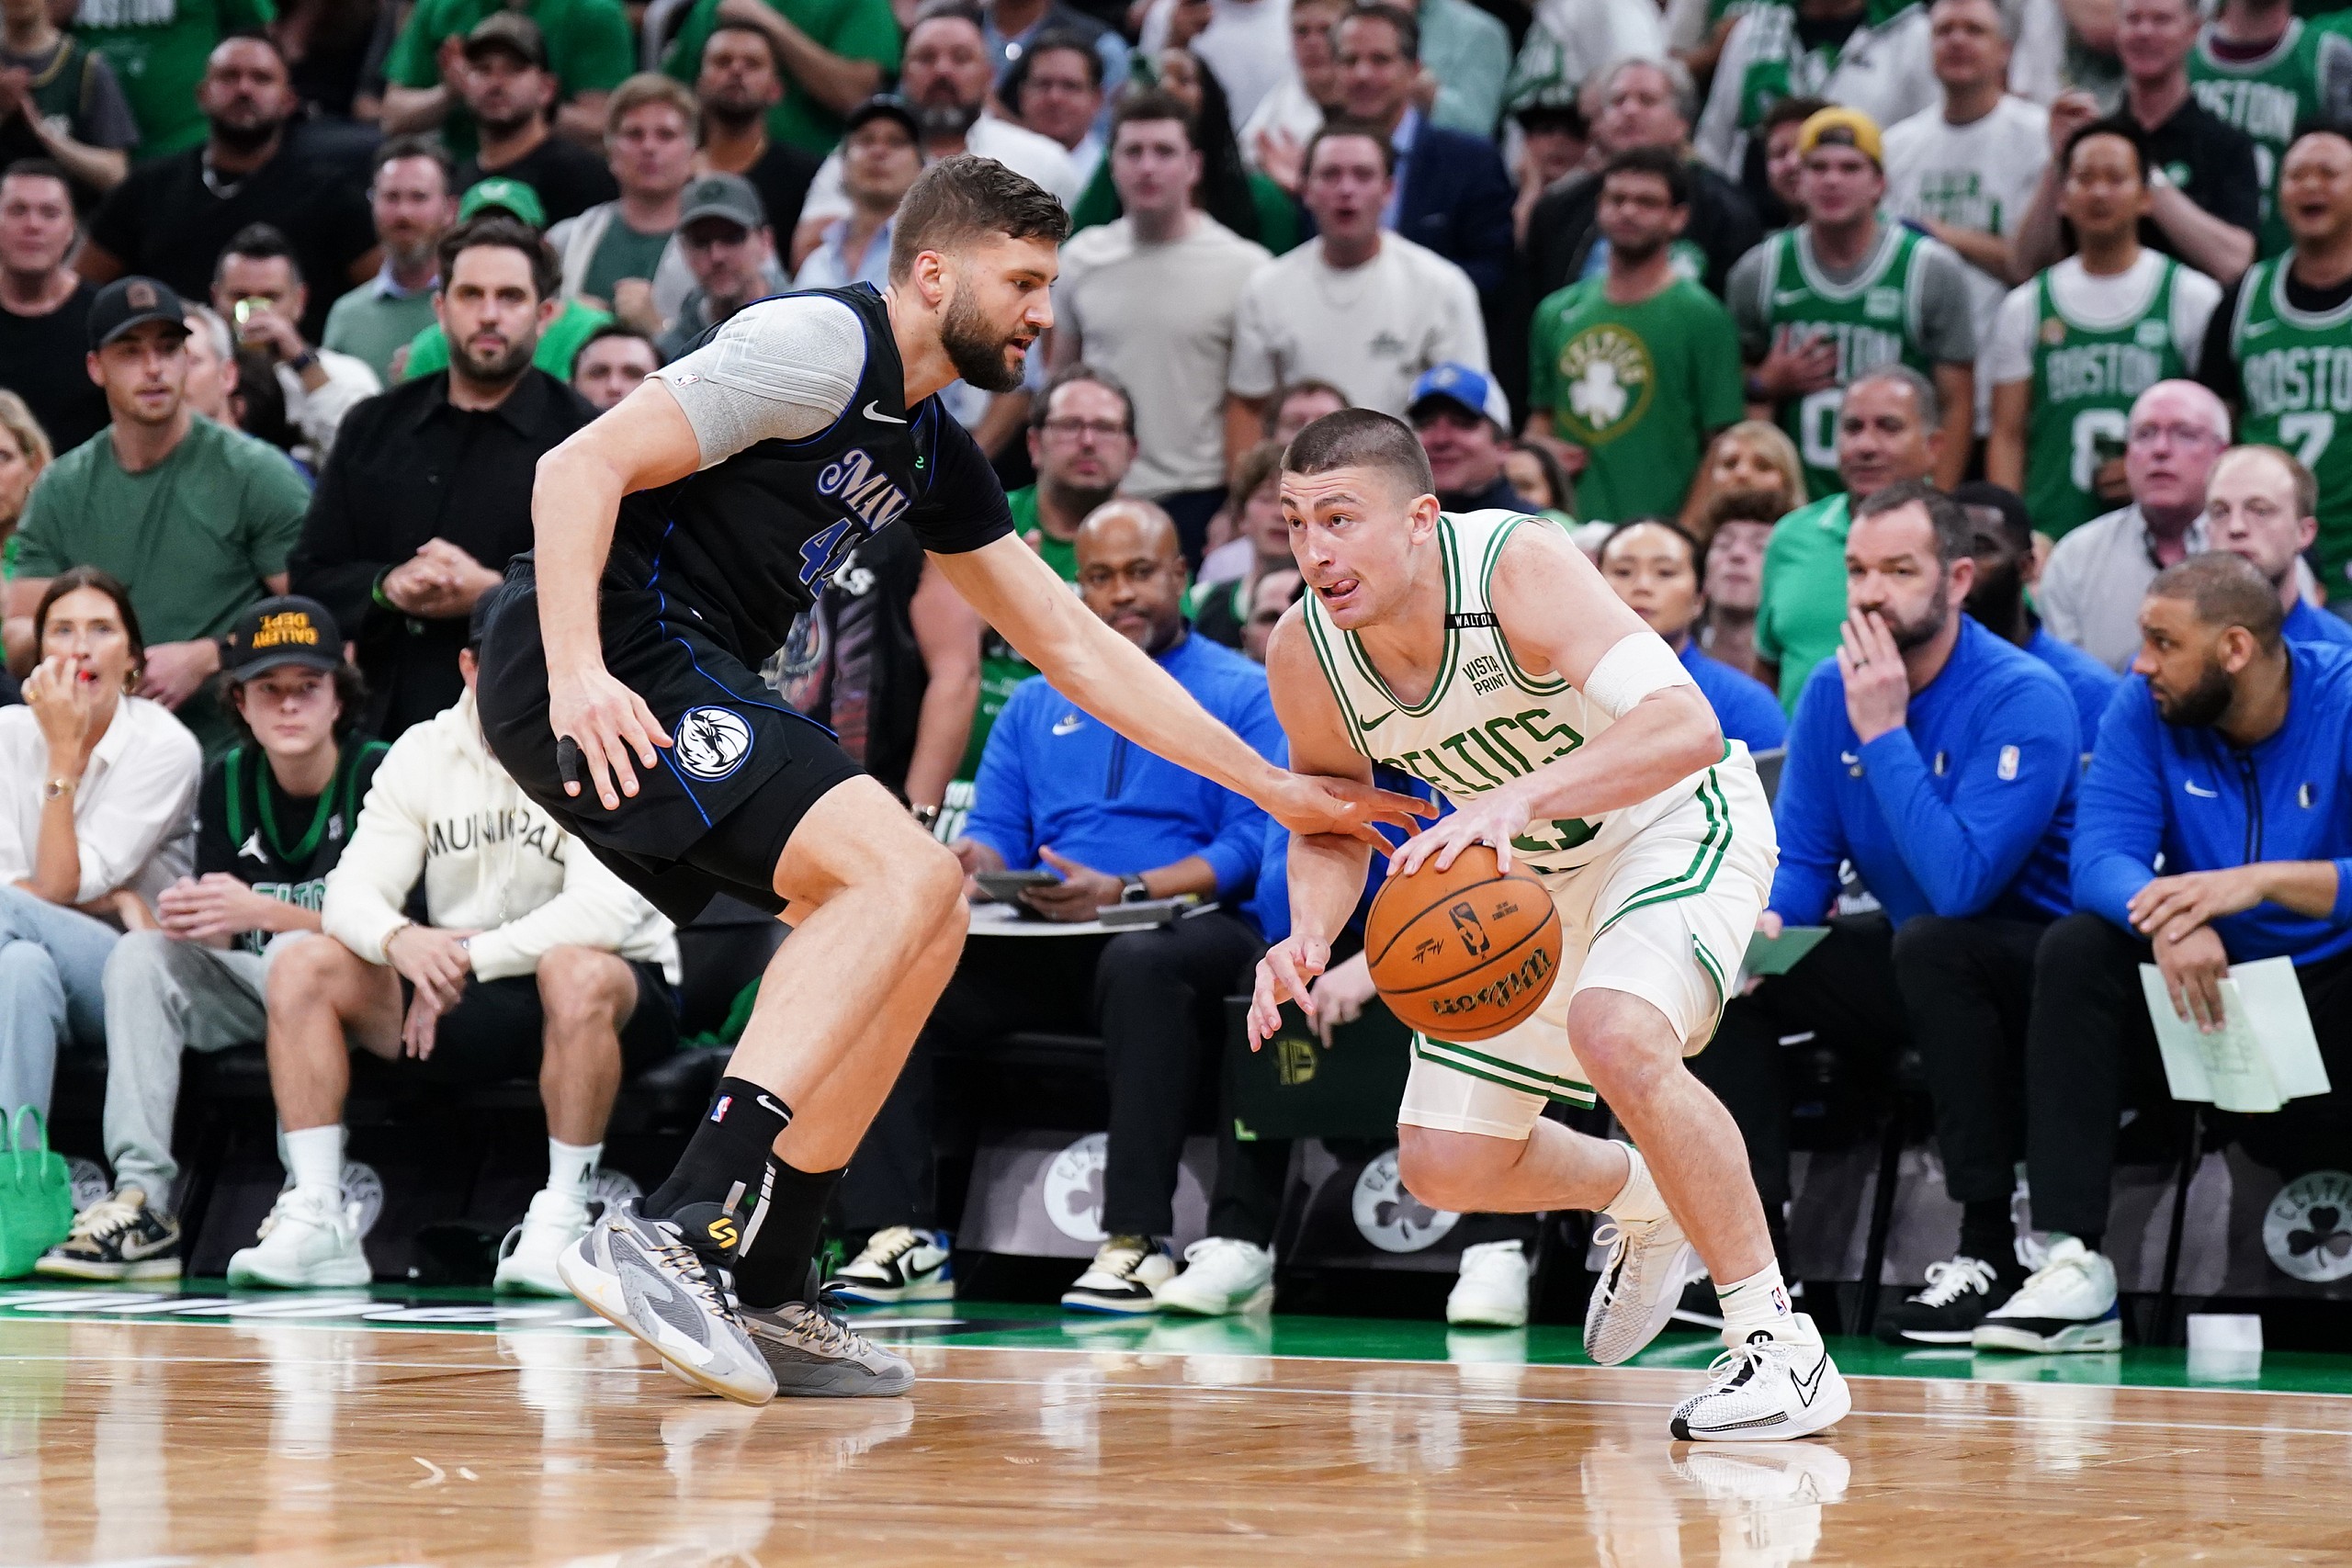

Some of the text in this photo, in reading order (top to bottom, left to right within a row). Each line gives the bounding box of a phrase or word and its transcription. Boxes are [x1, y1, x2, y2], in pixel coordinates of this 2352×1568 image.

[2278, 412, 2335, 469] 7
[1454, 614, 1493, 627] WALTON
[1462, 655, 1502, 682] VISTA
[1472, 672, 1509, 696] PRINT
[1429, 946, 1553, 1016] Wilson
